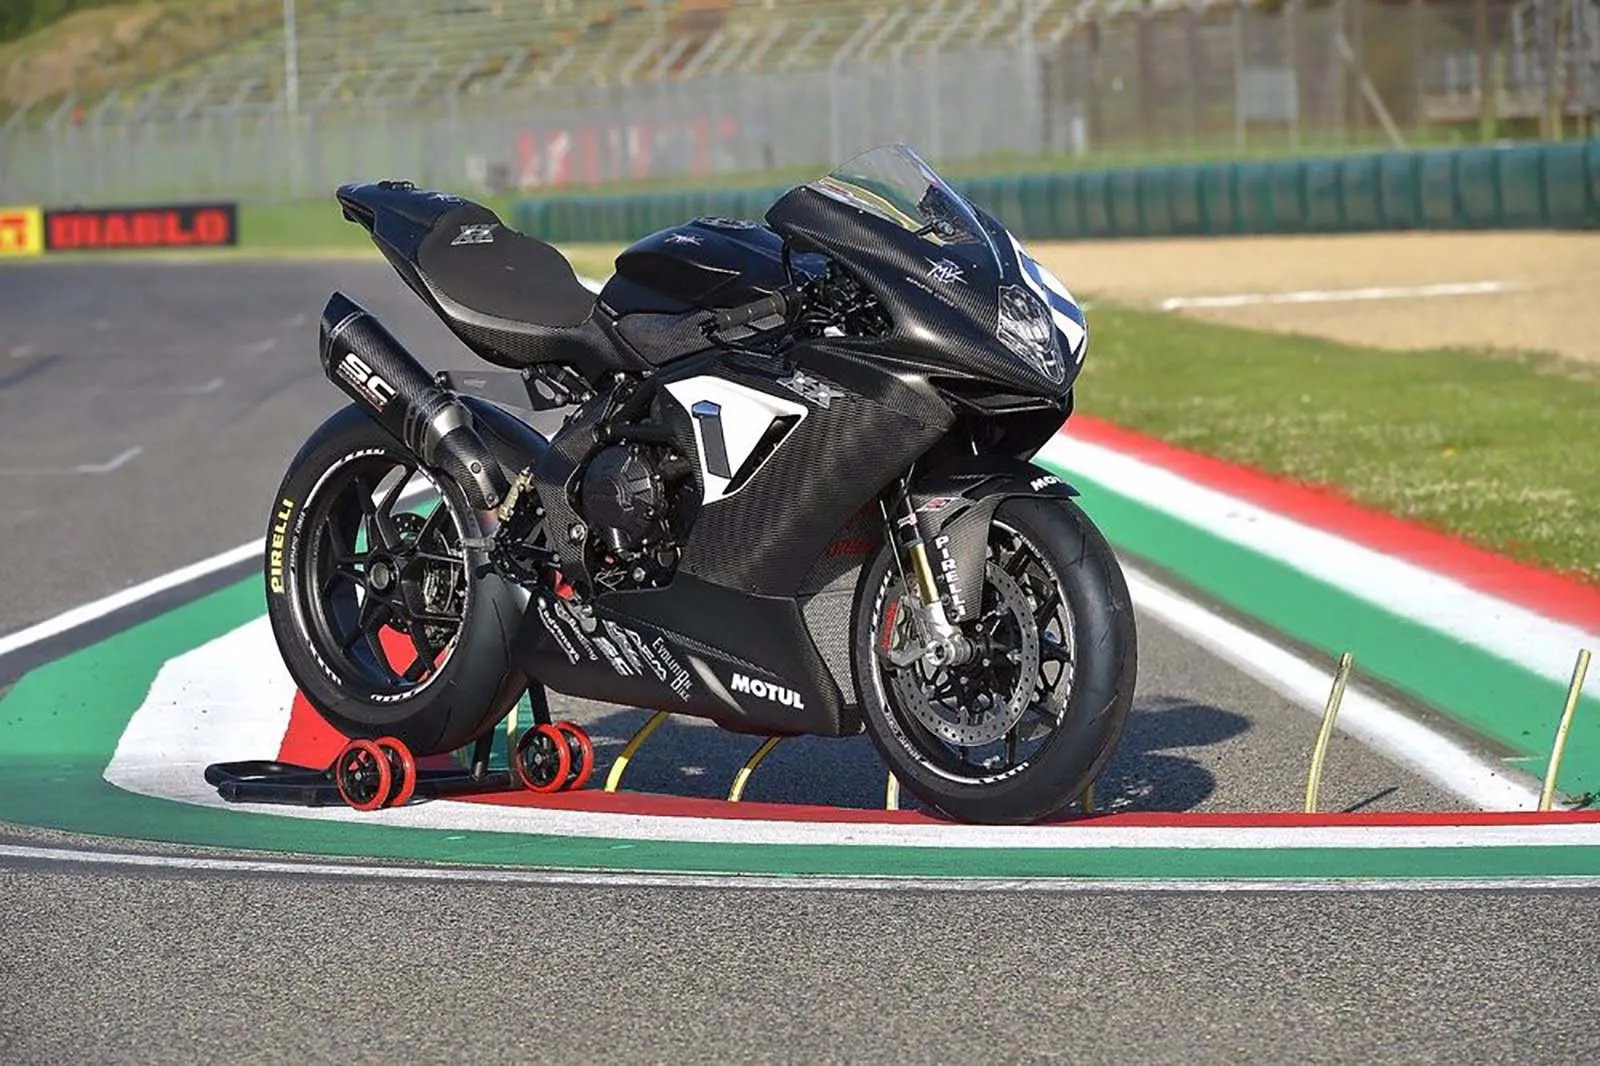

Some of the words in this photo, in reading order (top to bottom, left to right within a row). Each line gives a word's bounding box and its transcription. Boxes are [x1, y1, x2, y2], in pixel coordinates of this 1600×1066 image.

[52, 210, 229, 249] DIABLO
[341, 352, 397, 403] SC
[271, 498, 295, 594] PIRELLI
[935, 535, 967, 617] PIRELLI
[730, 672, 806, 711] MOTUL
